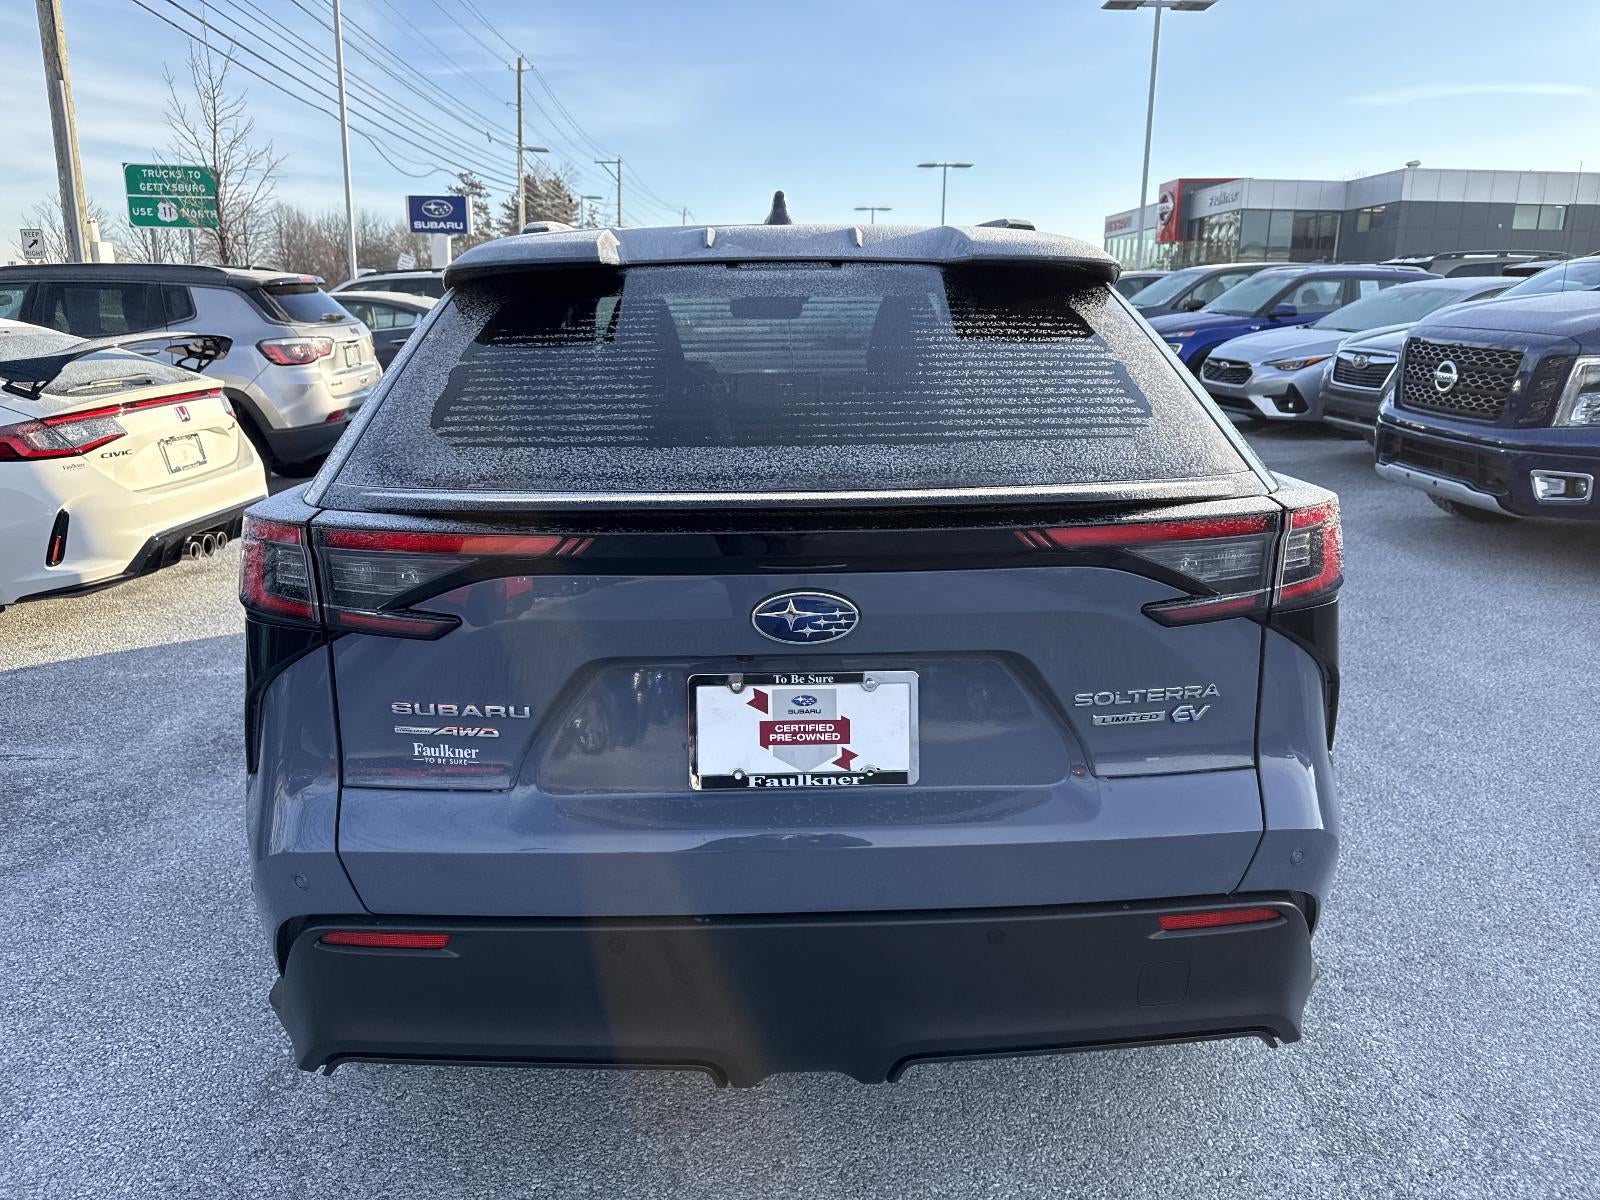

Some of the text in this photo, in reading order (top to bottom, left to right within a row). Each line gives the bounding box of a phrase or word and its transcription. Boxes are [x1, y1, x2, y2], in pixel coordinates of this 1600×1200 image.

[141, 169, 201, 179] TRUCKS TO
[140, 183, 206, 193] GETTYSBURG
[132, 207, 218, 218] USE 11 NORTH
[413, 221, 464, 229] SUBARU
[100, 448, 133, 459] CIVIC
[773, 674, 834, 684] To Be Sure
[1074, 683, 1221, 707] SOLTERRA
[391, 702, 531, 719] SUBARU
[1101, 704, 1212, 724] LIMITED EV
[433, 726, 500, 738] AWD
[774, 723, 835, 733] CERTIFIED
[769, 732, 841, 742] PRE-OWNED
[412, 742, 480, 759] Faulkner
[449, 758, 468, 766] SURE
[747, 774, 865, 788] Faulkner
